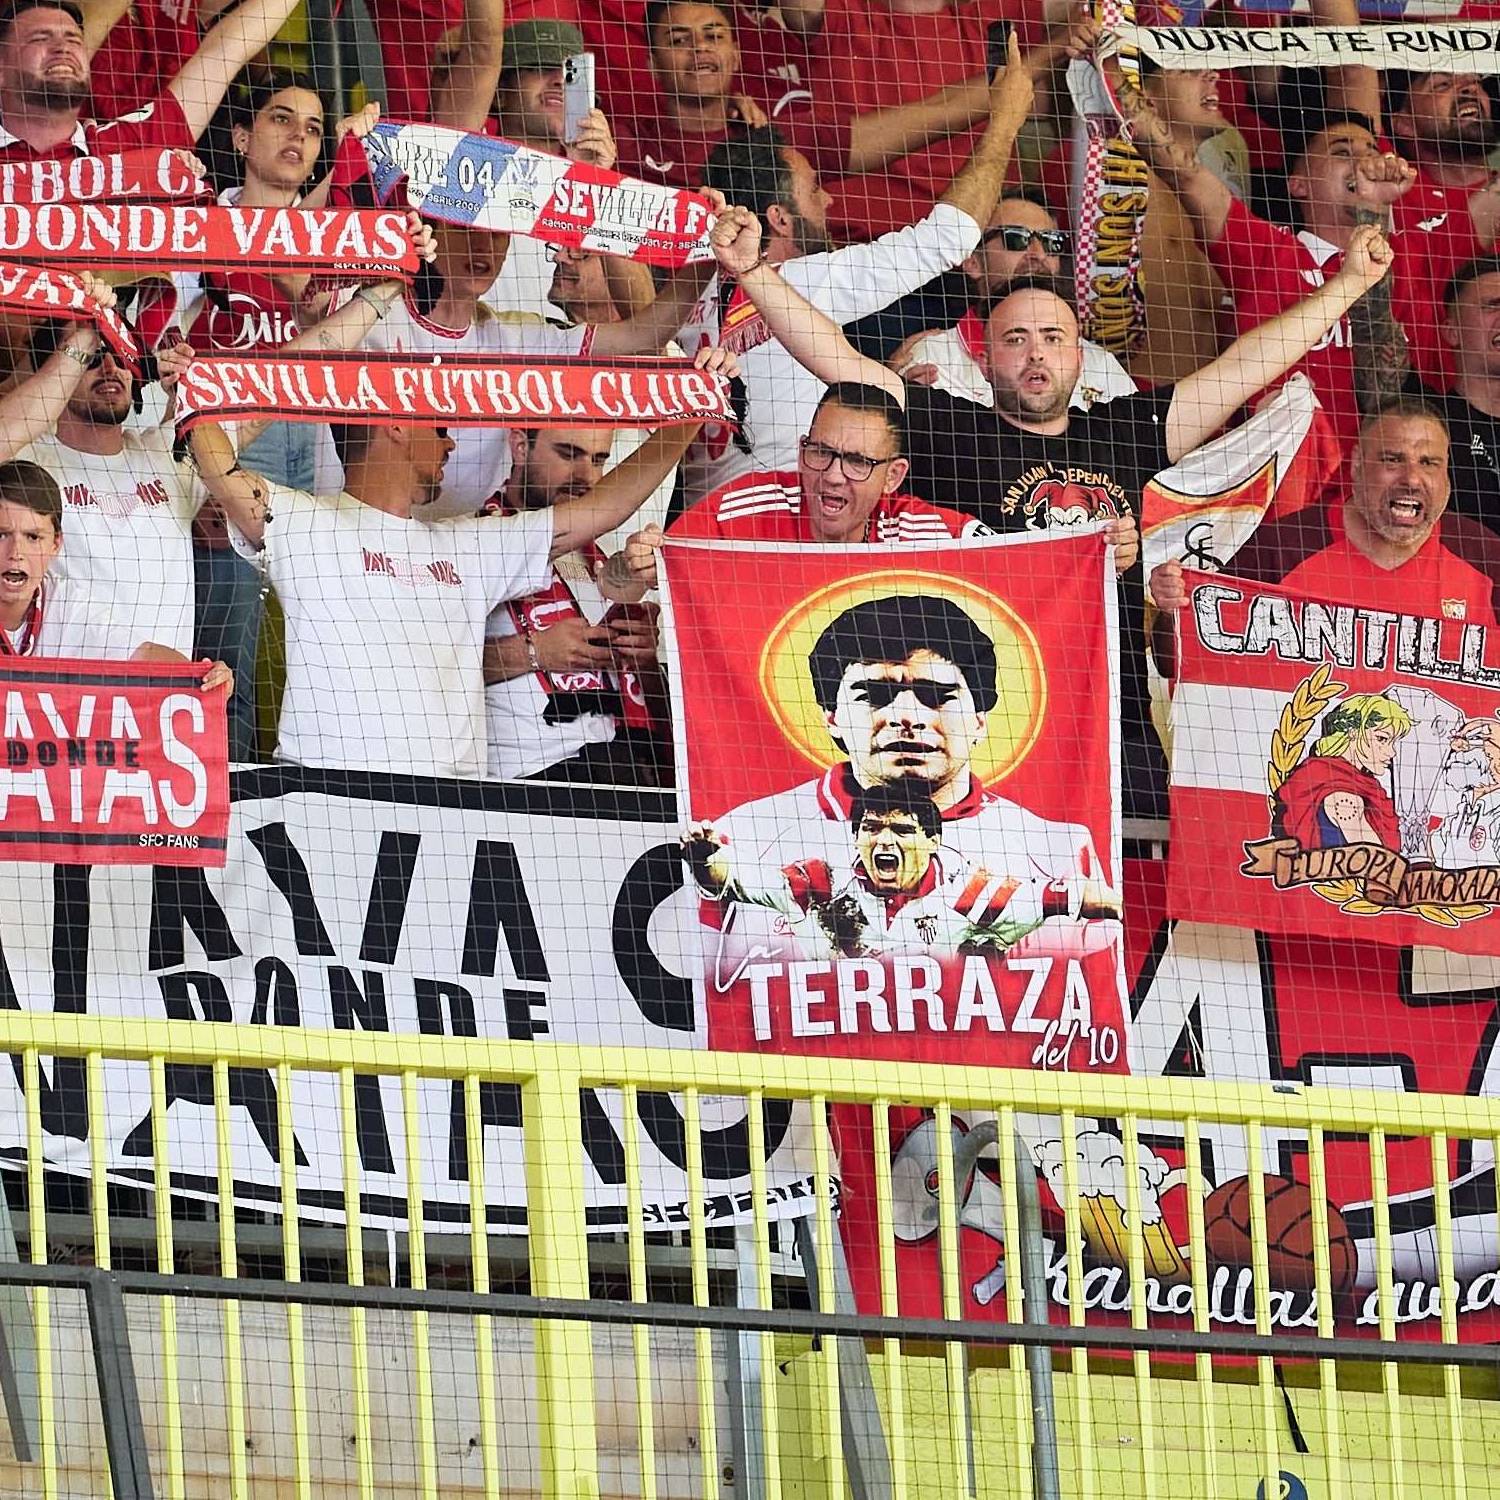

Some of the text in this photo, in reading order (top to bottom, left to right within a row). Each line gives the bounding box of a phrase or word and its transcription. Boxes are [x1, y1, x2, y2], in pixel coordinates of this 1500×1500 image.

[1151, 28, 1307, 54] NUNCA
[1314, 32, 1373, 54] TE
[459, 156, 496, 198] 04
[554, 179, 680, 232] SEVILLA
[232, 209, 406, 260] VAYAS
[191, 357, 727, 417] SEVILLA FÚTBOL CLUB
[1000, 466, 1047, 515] SAN JUAN
[6, 737, 141, 768] DONDE
[138, 833, 200, 849] SFC FANS
[1280, 848, 1398, 887] EUROPA
[715, 901, 1089, 1041] La TERRAZA
[1032, 1019, 1118, 1071] del 10
